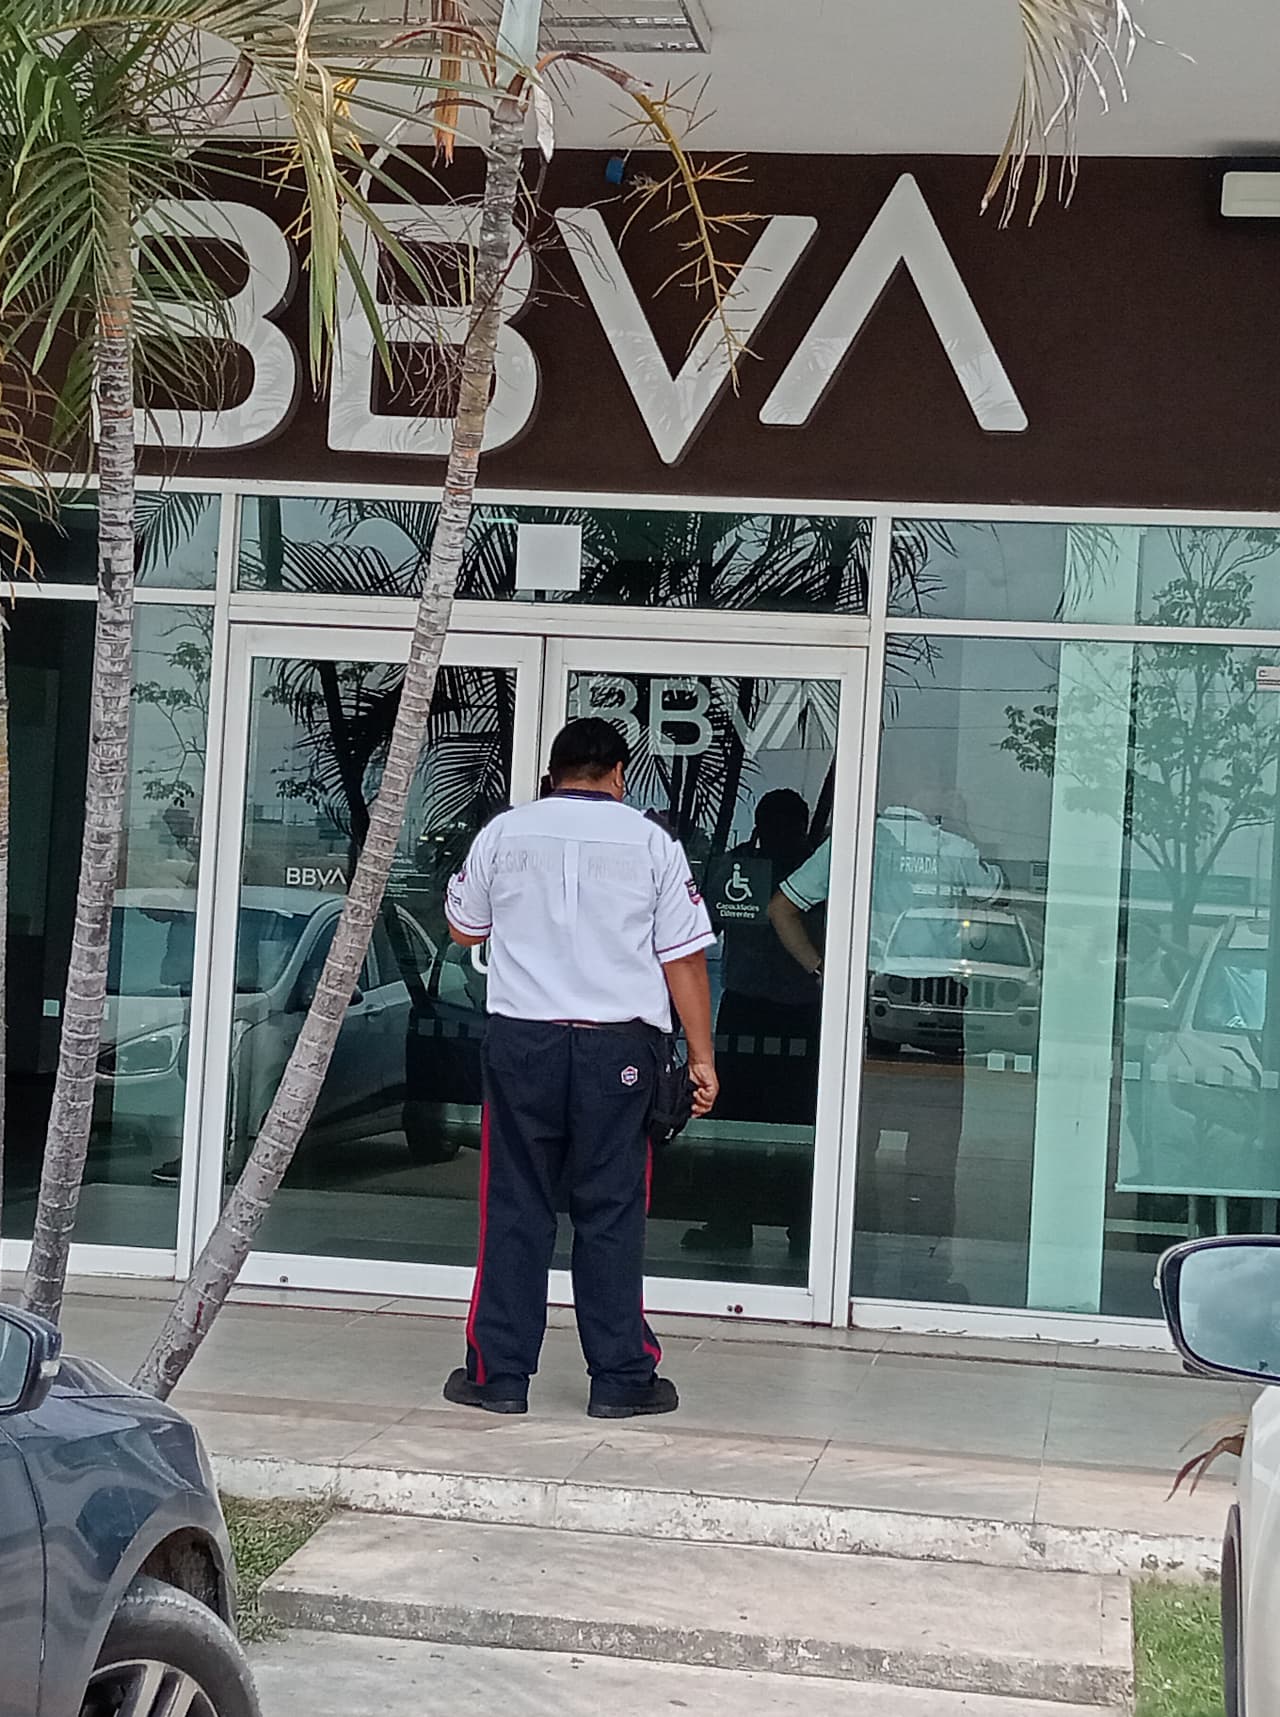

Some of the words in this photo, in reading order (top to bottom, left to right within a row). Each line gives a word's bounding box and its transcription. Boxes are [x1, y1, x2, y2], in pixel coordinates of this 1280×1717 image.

[93, 172, 1028, 464] BBVA
[899, 856, 938, 875] PRIVADA
[286, 867, 347, 886] BBVA
